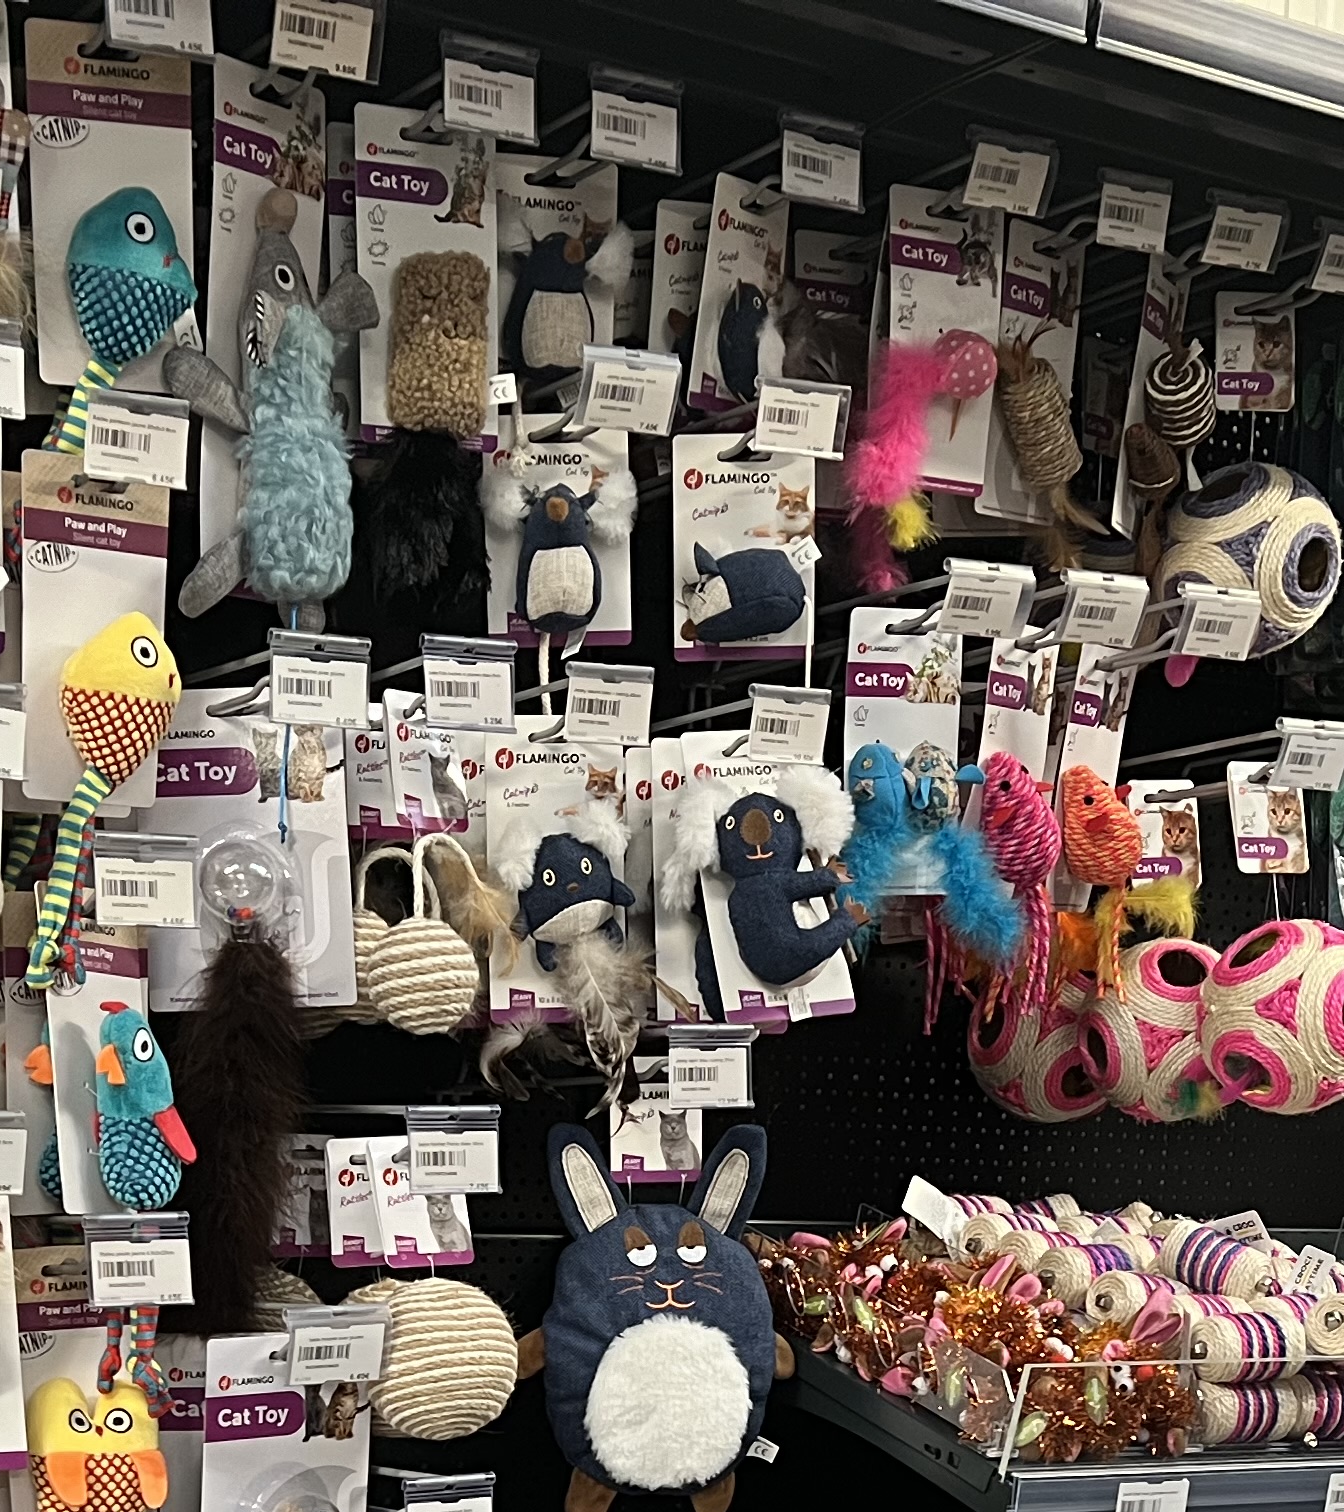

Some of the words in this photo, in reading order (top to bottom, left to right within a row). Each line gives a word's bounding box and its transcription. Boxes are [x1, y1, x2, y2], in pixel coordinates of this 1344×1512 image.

[84, 64, 150, 81] FLAMINGO
[42, 118, 81, 142] CATNIP
[223, 137, 247, 156] Cat
[249, 144, 273, 168] Toy
[369, 172, 396, 188] Cat
[400, 174, 429, 196] Toy
[902, 245, 921, 261] Cat
[924, 248, 948, 267] Toy
[1010, 283, 1027, 302] Cat
[1029, 287, 1045, 310] Toy
[1222, 379, 1238, 391] Cat
[1240, 379, 1259, 395] Toy
[704, 471, 771, 485] FLAMINGO
[75, 493, 134, 511] FLAMINGO
[36, 544, 71, 564] CATNIP
[855, 671, 878, 687] Cat
[880, 673, 904, 690] Toy
[992, 680, 1005, 697] Cat
[1007, 684, 1020, 701] Toy
[1074, 701, 1085, 714] Cat
[1086, 705, 1097, 717] Toy
[516, 752, 579, 765] FLAMINGO
[158, 761, 191, 781] Cat
[196, 761, 236, 784] Toy
[714, 765, 771, 777] FLAMINGO
[1242, 842, 1257, 853] Cat
[1259, 842, 1275, 855] Toy
[1136, 863, 1151, 873] Cat
[1153, 863, 1169, 876] Toy
[1295, 1254, 1312, 1285] CROCI
[232, 1375, 274, 1387] FLAMINGO
[217, 1406, 249, 1428] Cat
[252, 1404, 288, 1429] Toy
